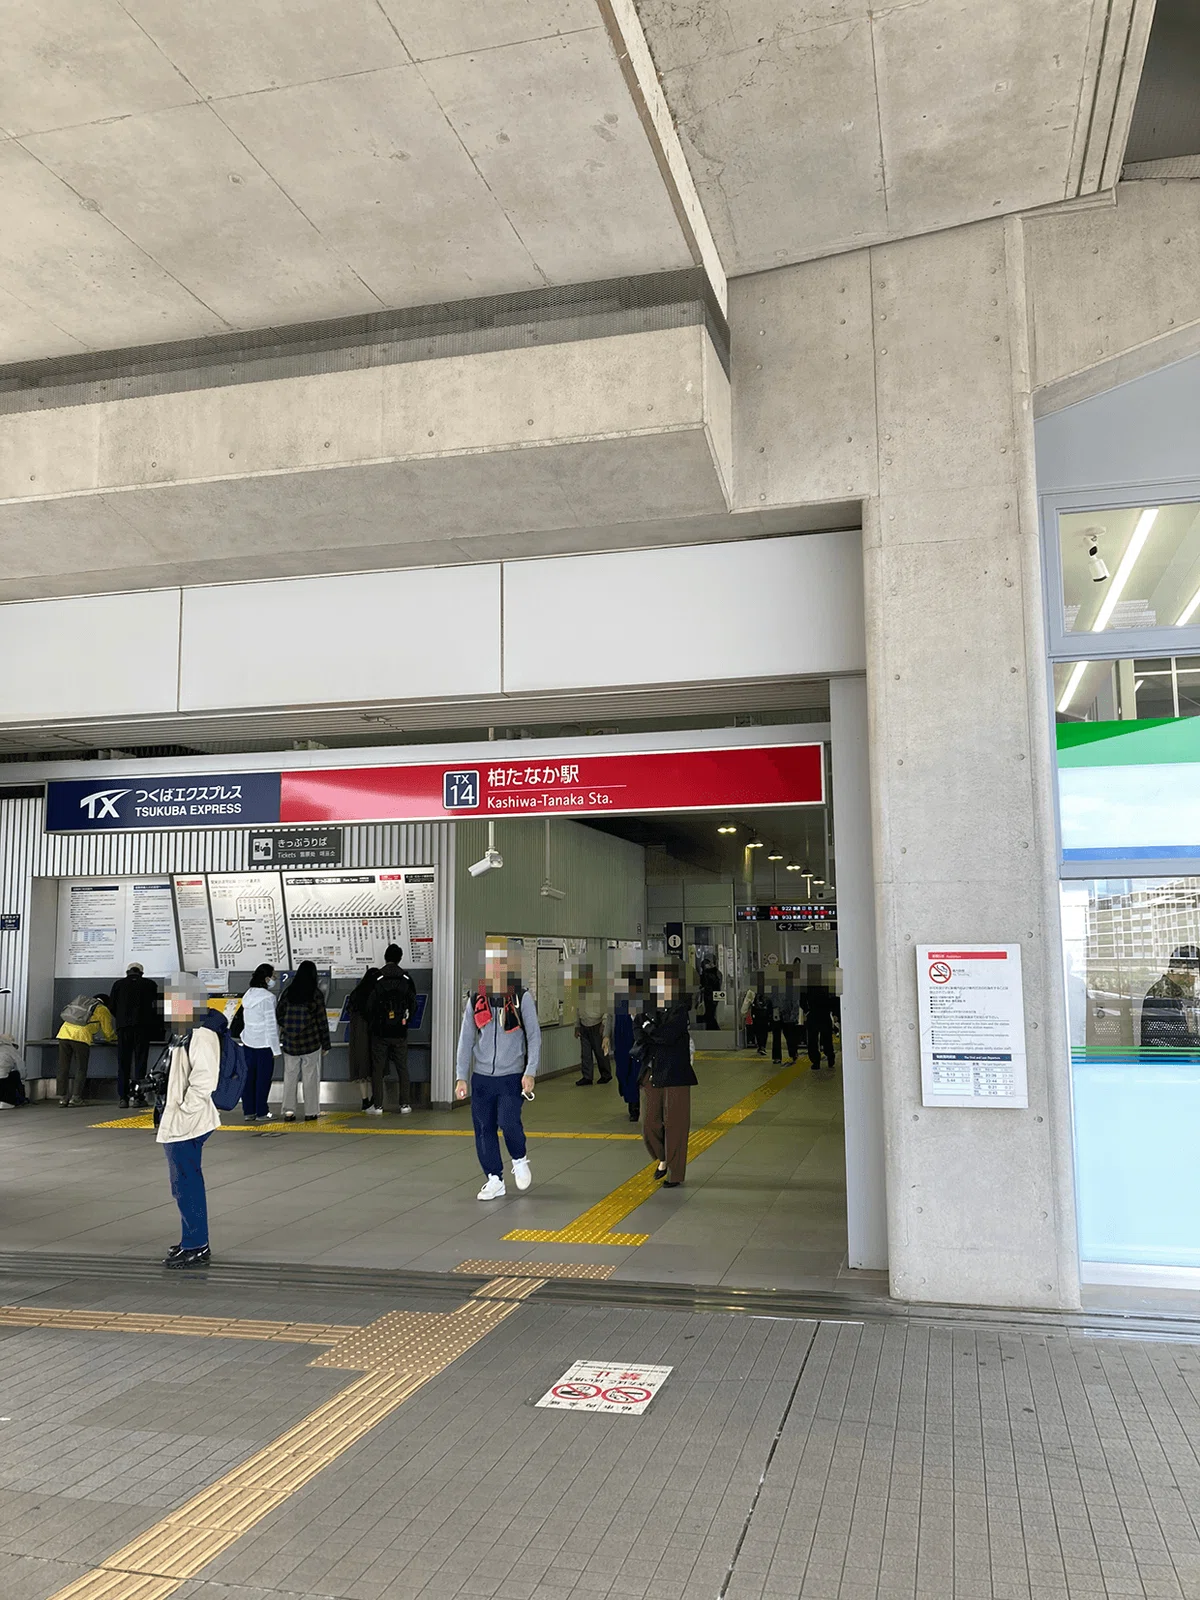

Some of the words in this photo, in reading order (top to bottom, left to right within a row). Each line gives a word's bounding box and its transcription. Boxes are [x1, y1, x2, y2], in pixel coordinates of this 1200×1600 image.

[453, 774, 470, 785] TX
[487, 764, 579, 787] 柏たなか駅
[135, 785, 242, 803] つくばエクスプレス
[450, 784, 475, 806] 14
[487, 793, 584, 809] Kashiwa-Tanaka
[588, 791, 613, 805] Sta.
[135, 805, 187, 817] TSUKUBA
[189, 803, 242, 815] EXPRESS
[277, 837, 328, 848] きっぷうりば
[278, 851, 297, 859] Tickets
